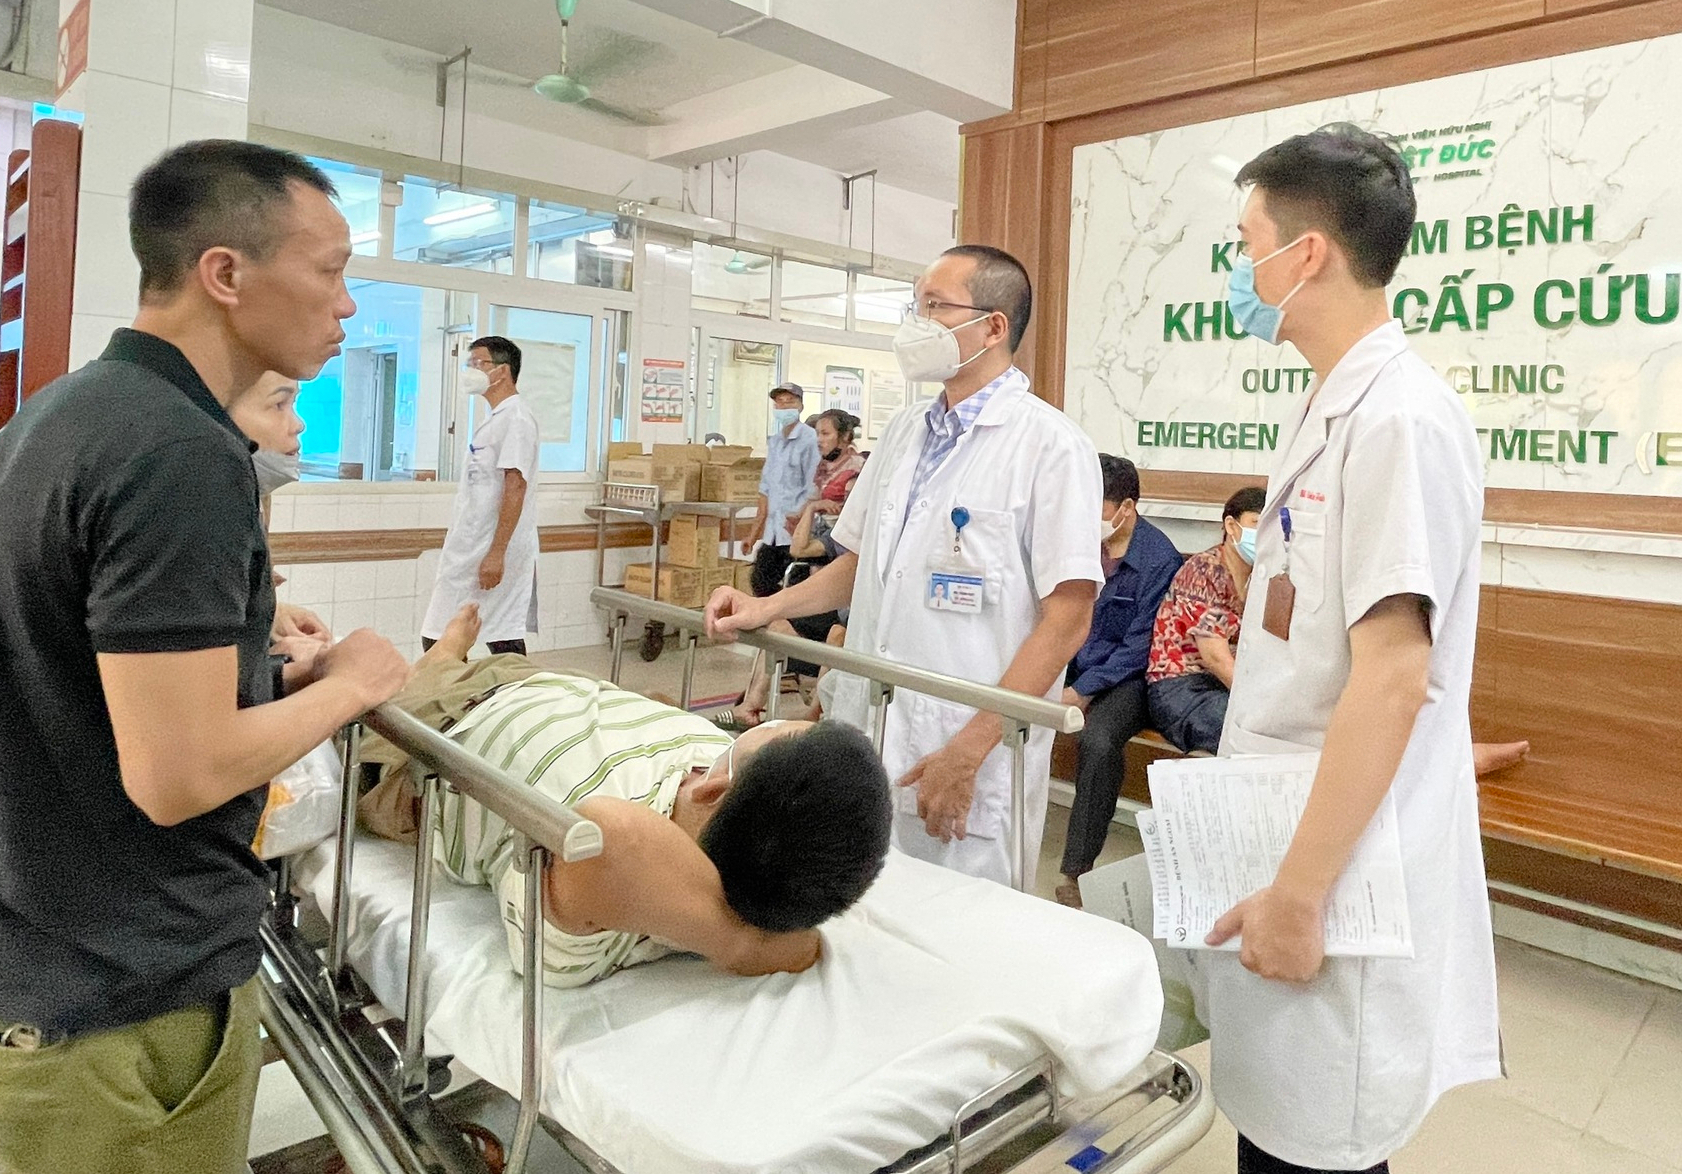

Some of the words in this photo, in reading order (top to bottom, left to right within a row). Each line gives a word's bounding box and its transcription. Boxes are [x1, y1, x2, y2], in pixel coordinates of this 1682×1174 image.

[1439, 134, 1496, 164] ĐỨC
[1434, 169, 1482, 181] HOSPITAL
[1465, 203, 1594, 256] BỆNH
[1392, 268, 1515, 334] CẤP
[1533, 262, 1681, 331] CỨU
[1445, 364, 1566, 395] CLINIC
[1137, 420, 1280, 451] EMERGEN
